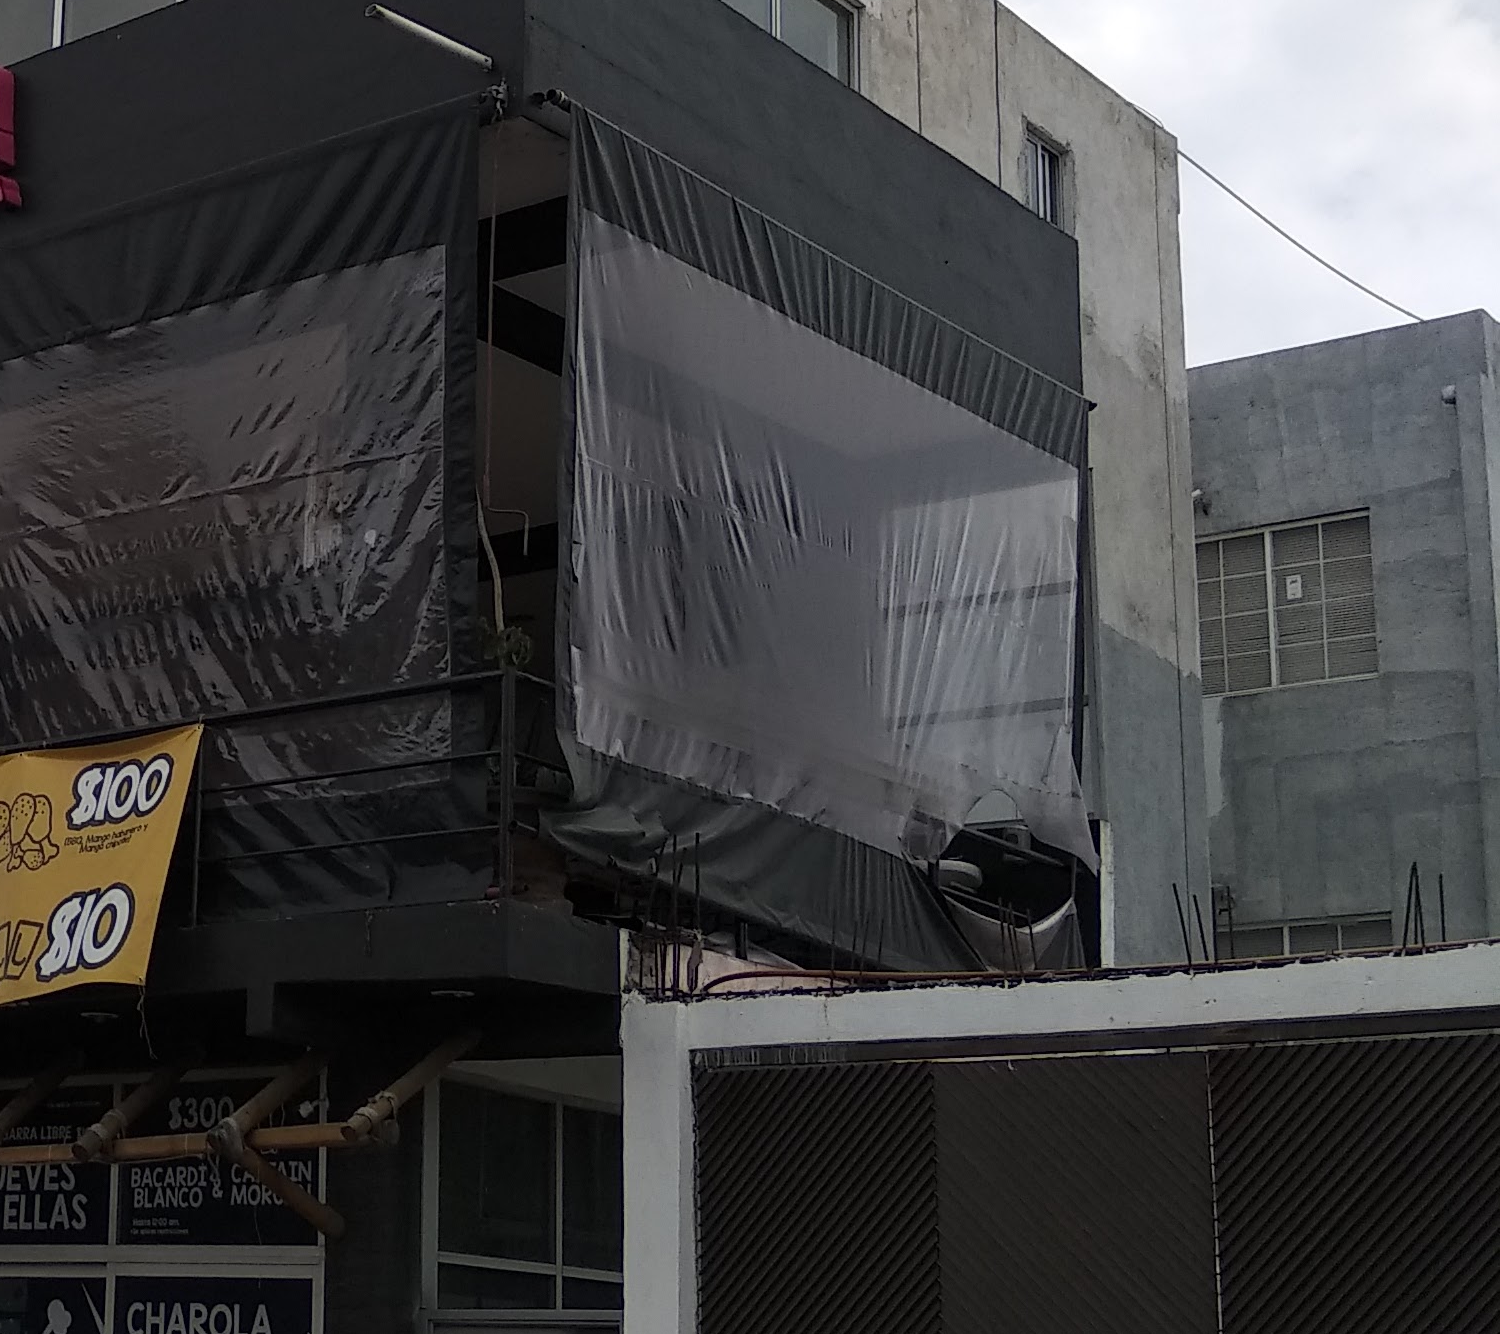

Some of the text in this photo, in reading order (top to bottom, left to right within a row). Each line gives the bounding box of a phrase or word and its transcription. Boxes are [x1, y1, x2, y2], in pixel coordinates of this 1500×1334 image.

[69, 753, 173, 829] $100
[37, 884, 135, 980] $10
[167, 1096, 235, 1130] $300
[3, 1126, 38, 1141] ARRA
[40, 1125, 73, 1140] LIBRE
[2, 1193, 89, 1232] ELLAS
[133, 1187, 204, 1209] BLANCO
